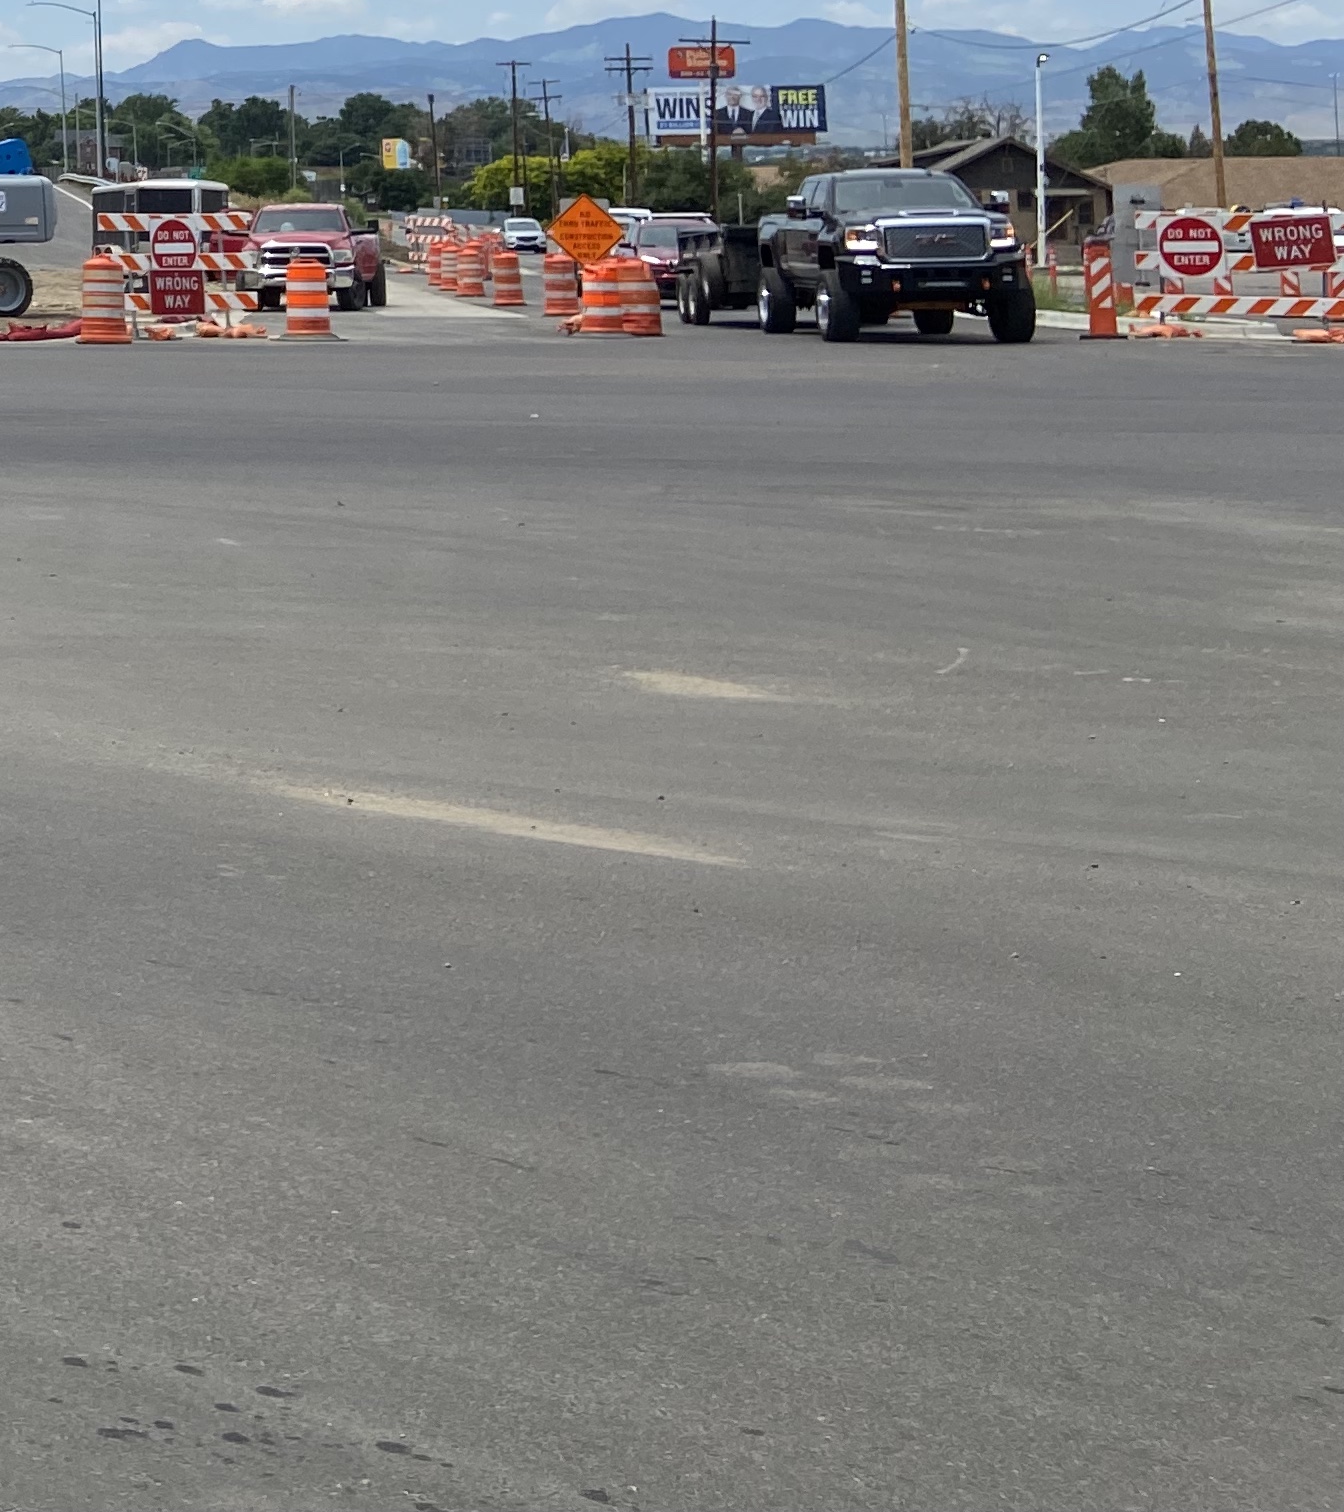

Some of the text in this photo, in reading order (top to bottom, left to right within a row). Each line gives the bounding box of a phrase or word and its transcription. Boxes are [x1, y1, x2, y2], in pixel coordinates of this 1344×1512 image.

[778, 89, 818, 104] FREE
[780, 109, 820, 128] WIN
[581, 220, 613, 228] TRAFFIC
[157, 230, 190, 240] DO NOT
[1167, 228, 1212, 239] DO NOT
[1259, 223, 1324, 242] WRONG
[1274, 243, 1313, 261] WAY
[162, 256, 189, 266] ENTER
[1173, 254, 1210, 266] ENTER
[155, 276, 199, 291] WRONG
[164, 294, 191, 308] WAY
